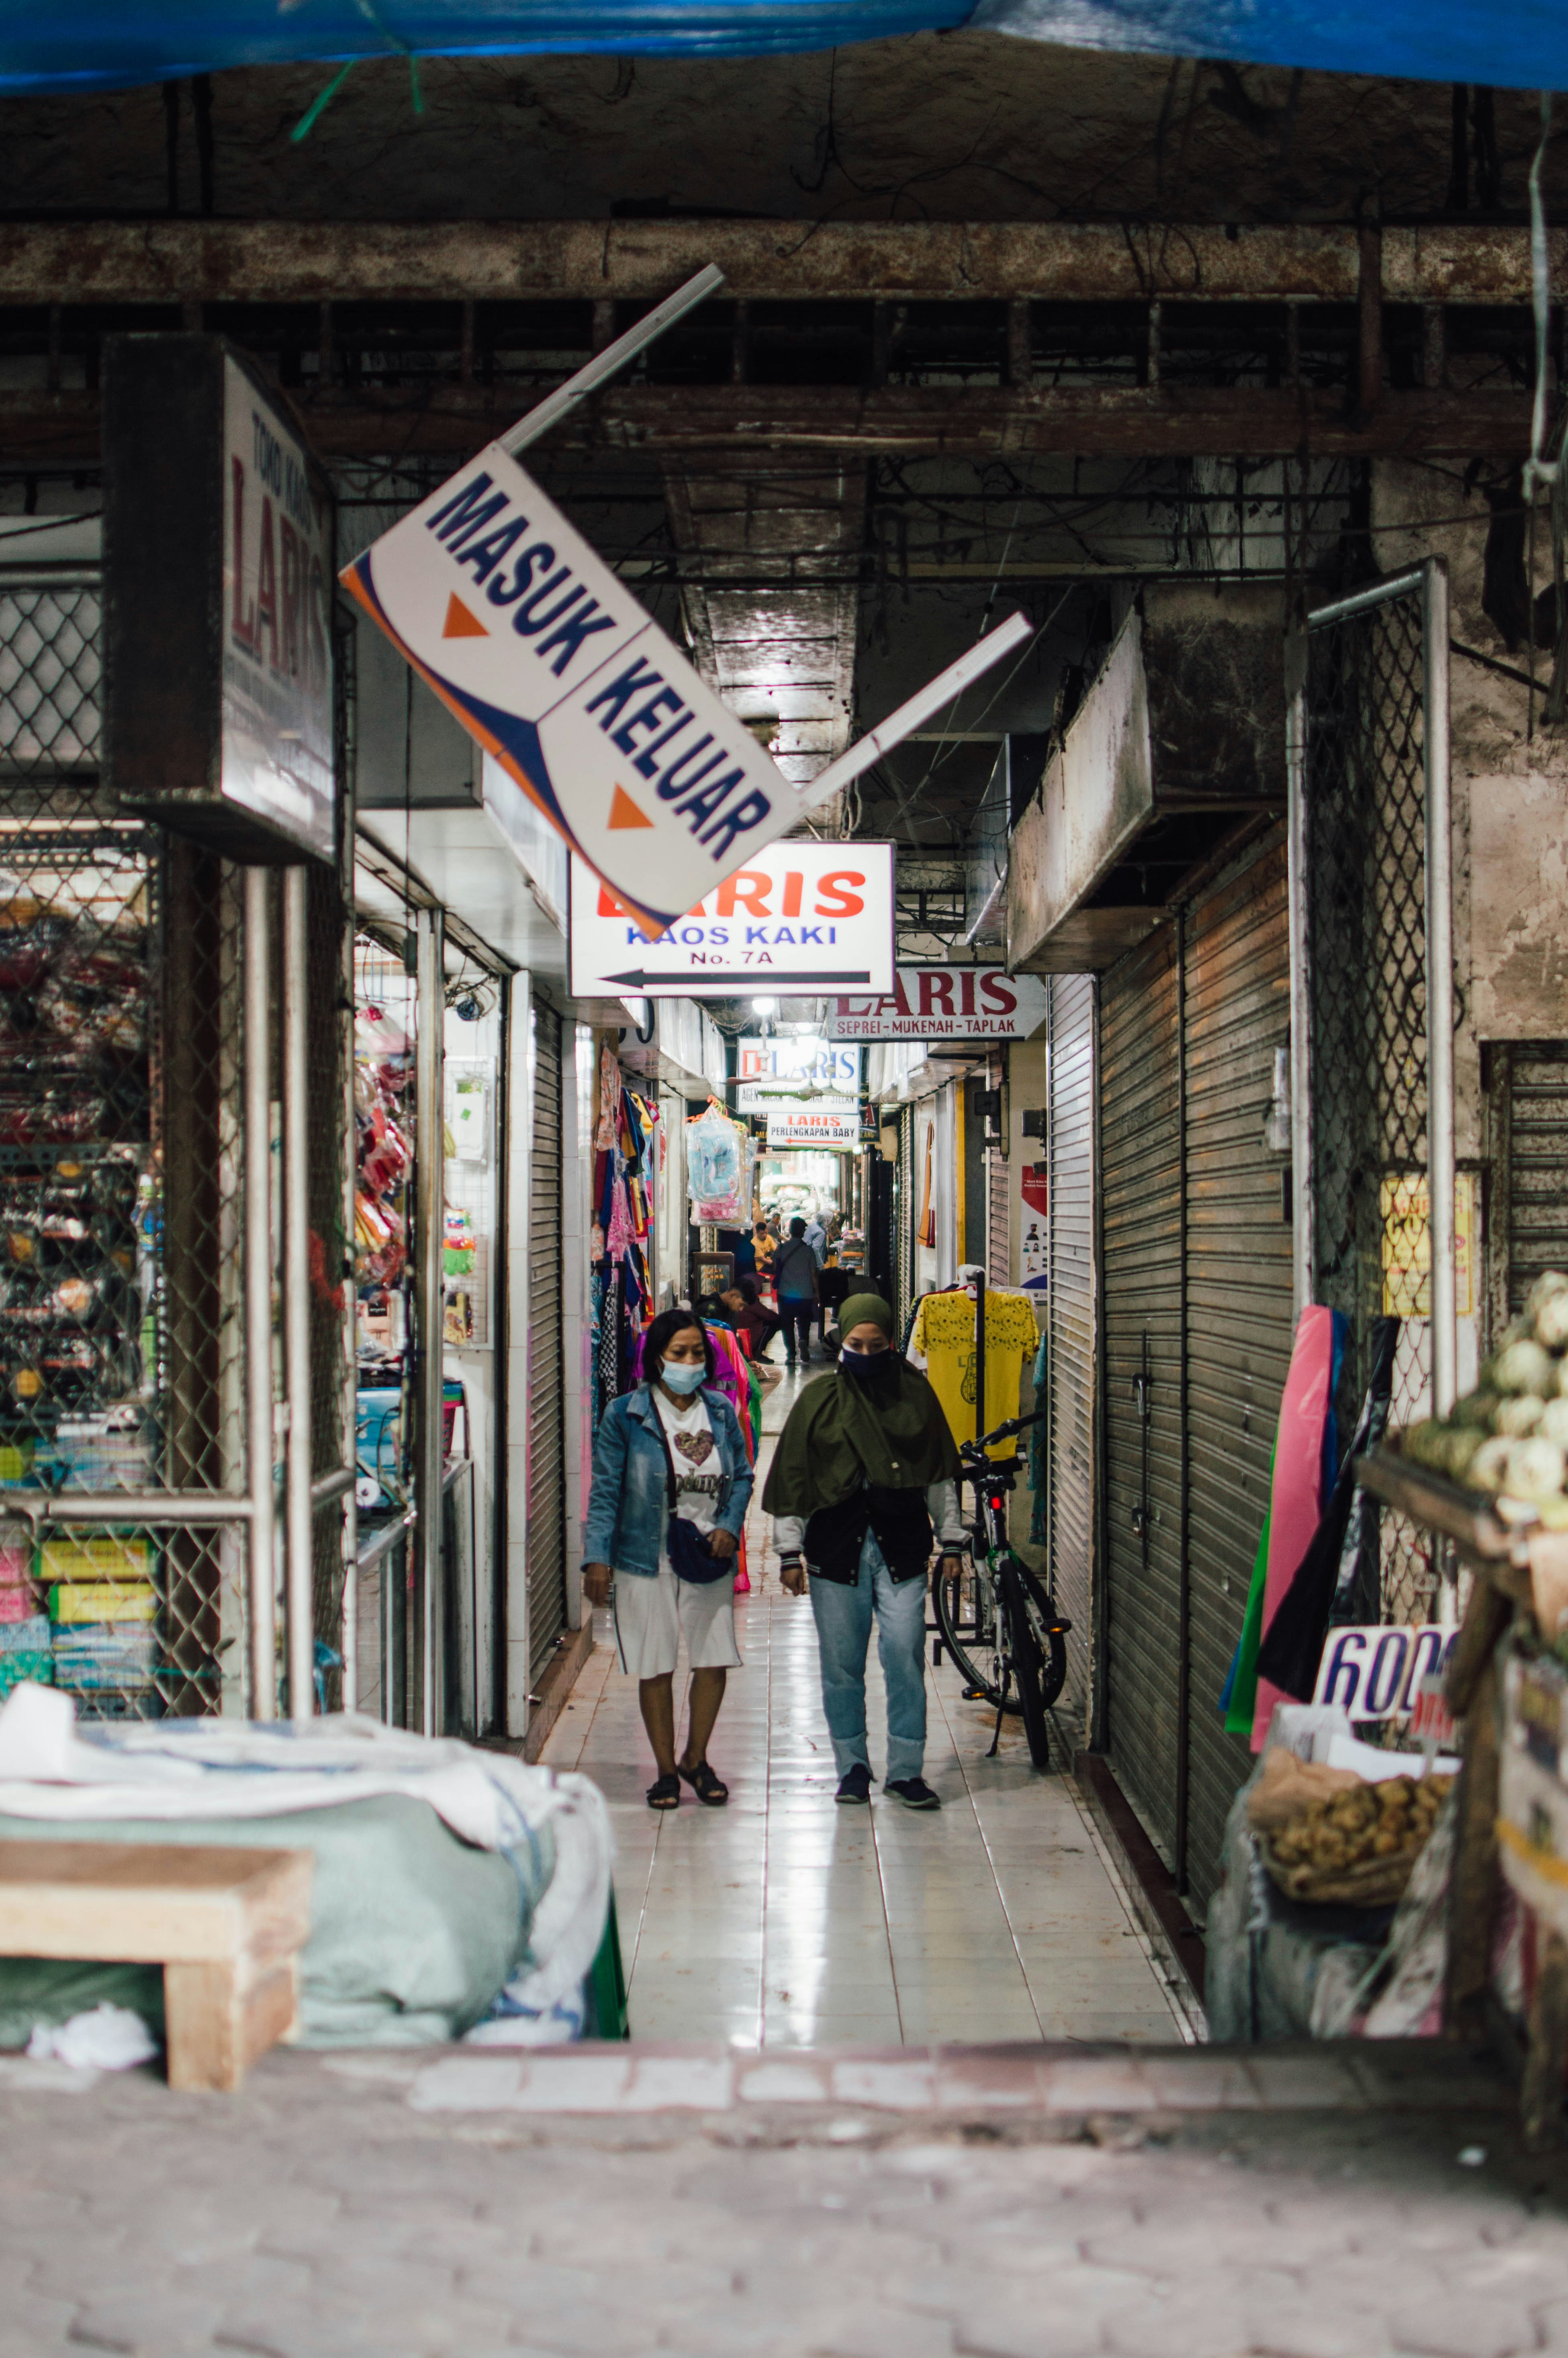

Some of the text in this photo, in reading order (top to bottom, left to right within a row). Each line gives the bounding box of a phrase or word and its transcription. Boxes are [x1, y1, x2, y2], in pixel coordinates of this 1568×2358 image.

[425, 471, 617, 678] MASUK
[583, 657, 772, 863] KELUAR
[597, 870, 866, 917] LRIS
[746, 926, 836, 944] KAKI
[690, 952, 774, 964] No. 7A
[838, 1021, 881, 1034] SEPREI
[892, 1020, 953, 1033] MUKENAH
[966, 1020, 1015, 1033] TAPLAK
[787, 1115, 841, 1127] LARIS
[771, 1126, 855, 1138] PERLENGKAPAN BABY
[1323, 1631, 1460, 1714] 600
